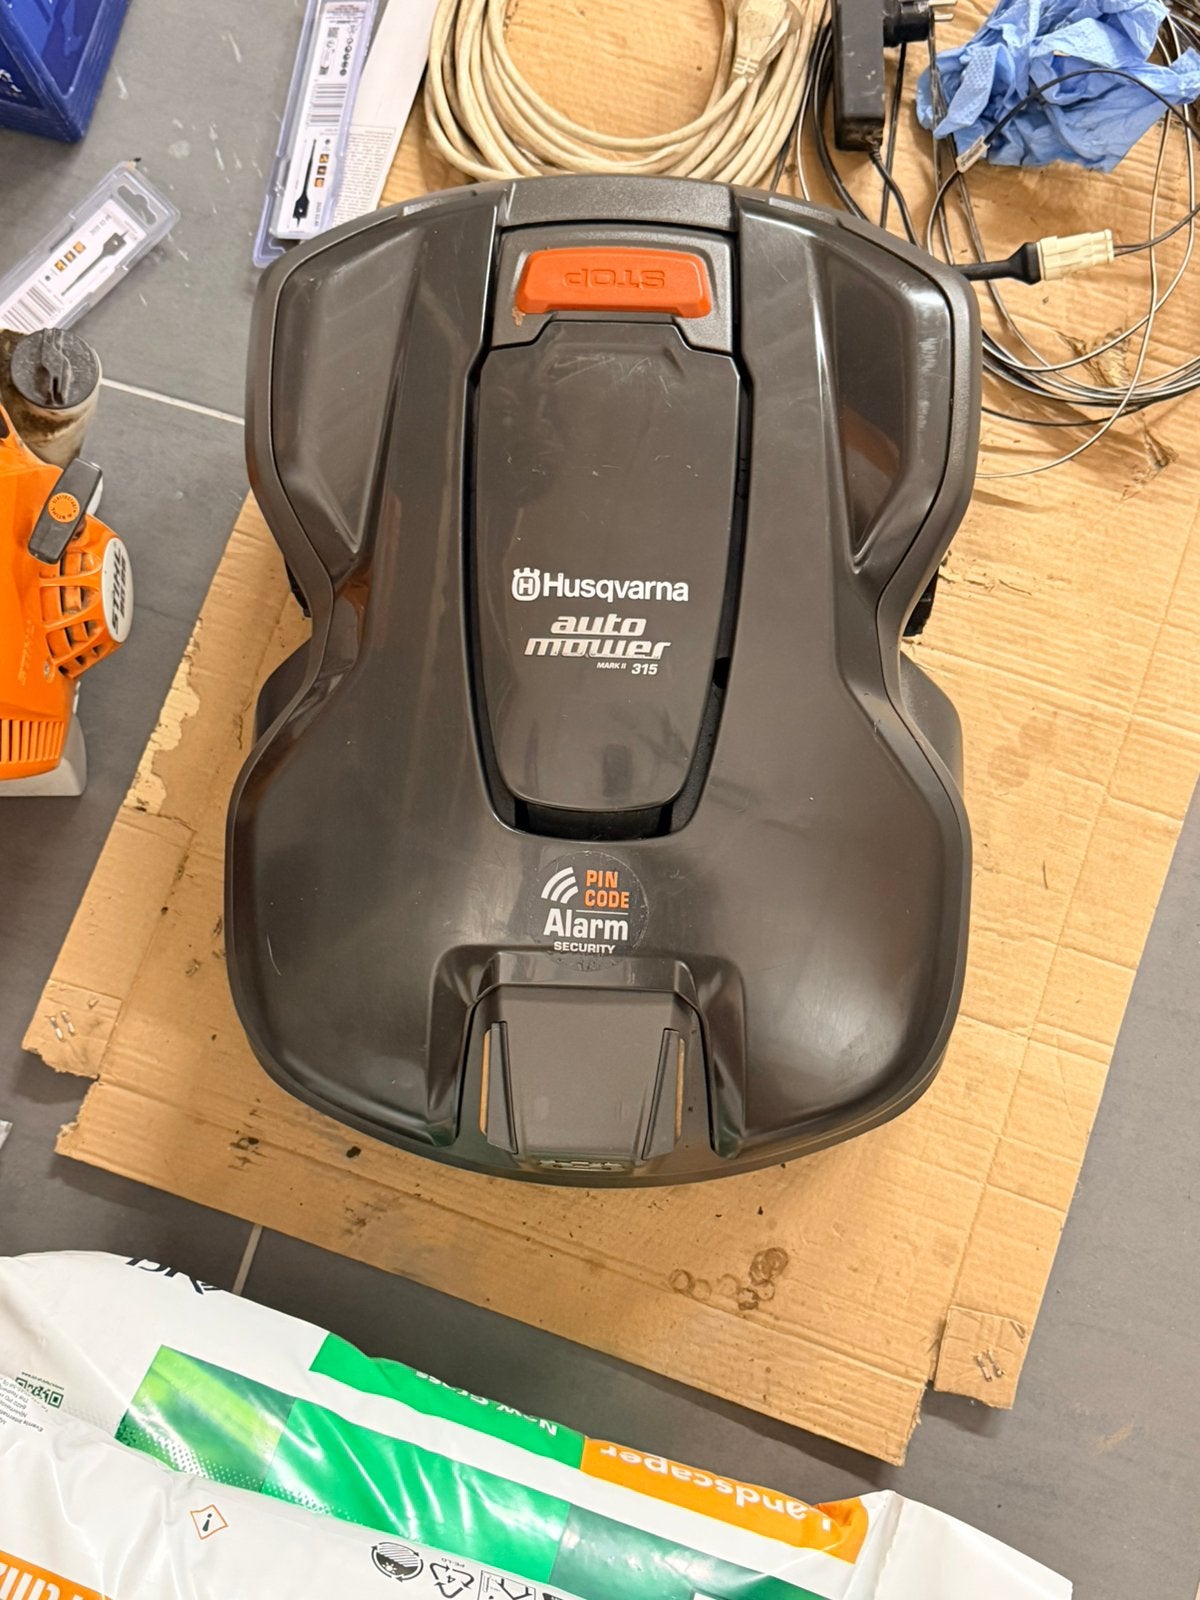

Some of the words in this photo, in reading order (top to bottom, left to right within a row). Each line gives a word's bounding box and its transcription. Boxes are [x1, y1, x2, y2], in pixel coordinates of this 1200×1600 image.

[563, 268, 666, 289] STOP
[111, 548, 121, 635] STIHL
[542, 572, 689, 603] Husqvarna
[551, 613, 647, 637] auto
[523, 637, 671, 660] mower
[597, 661, 620, 670] MARK
[620, 662, 627, 670] II
[631, 663, 658, 675] 315
[585, 869, 619, 889] PIN
[584, 889, 630, 909] CODE
[543, 907, 629, 941] Alarm
[554, 941, 616, 955] SECURITY
[600, 1445, 832, 1531] Landscaper
[447, 1574, 456, 1584] 4
